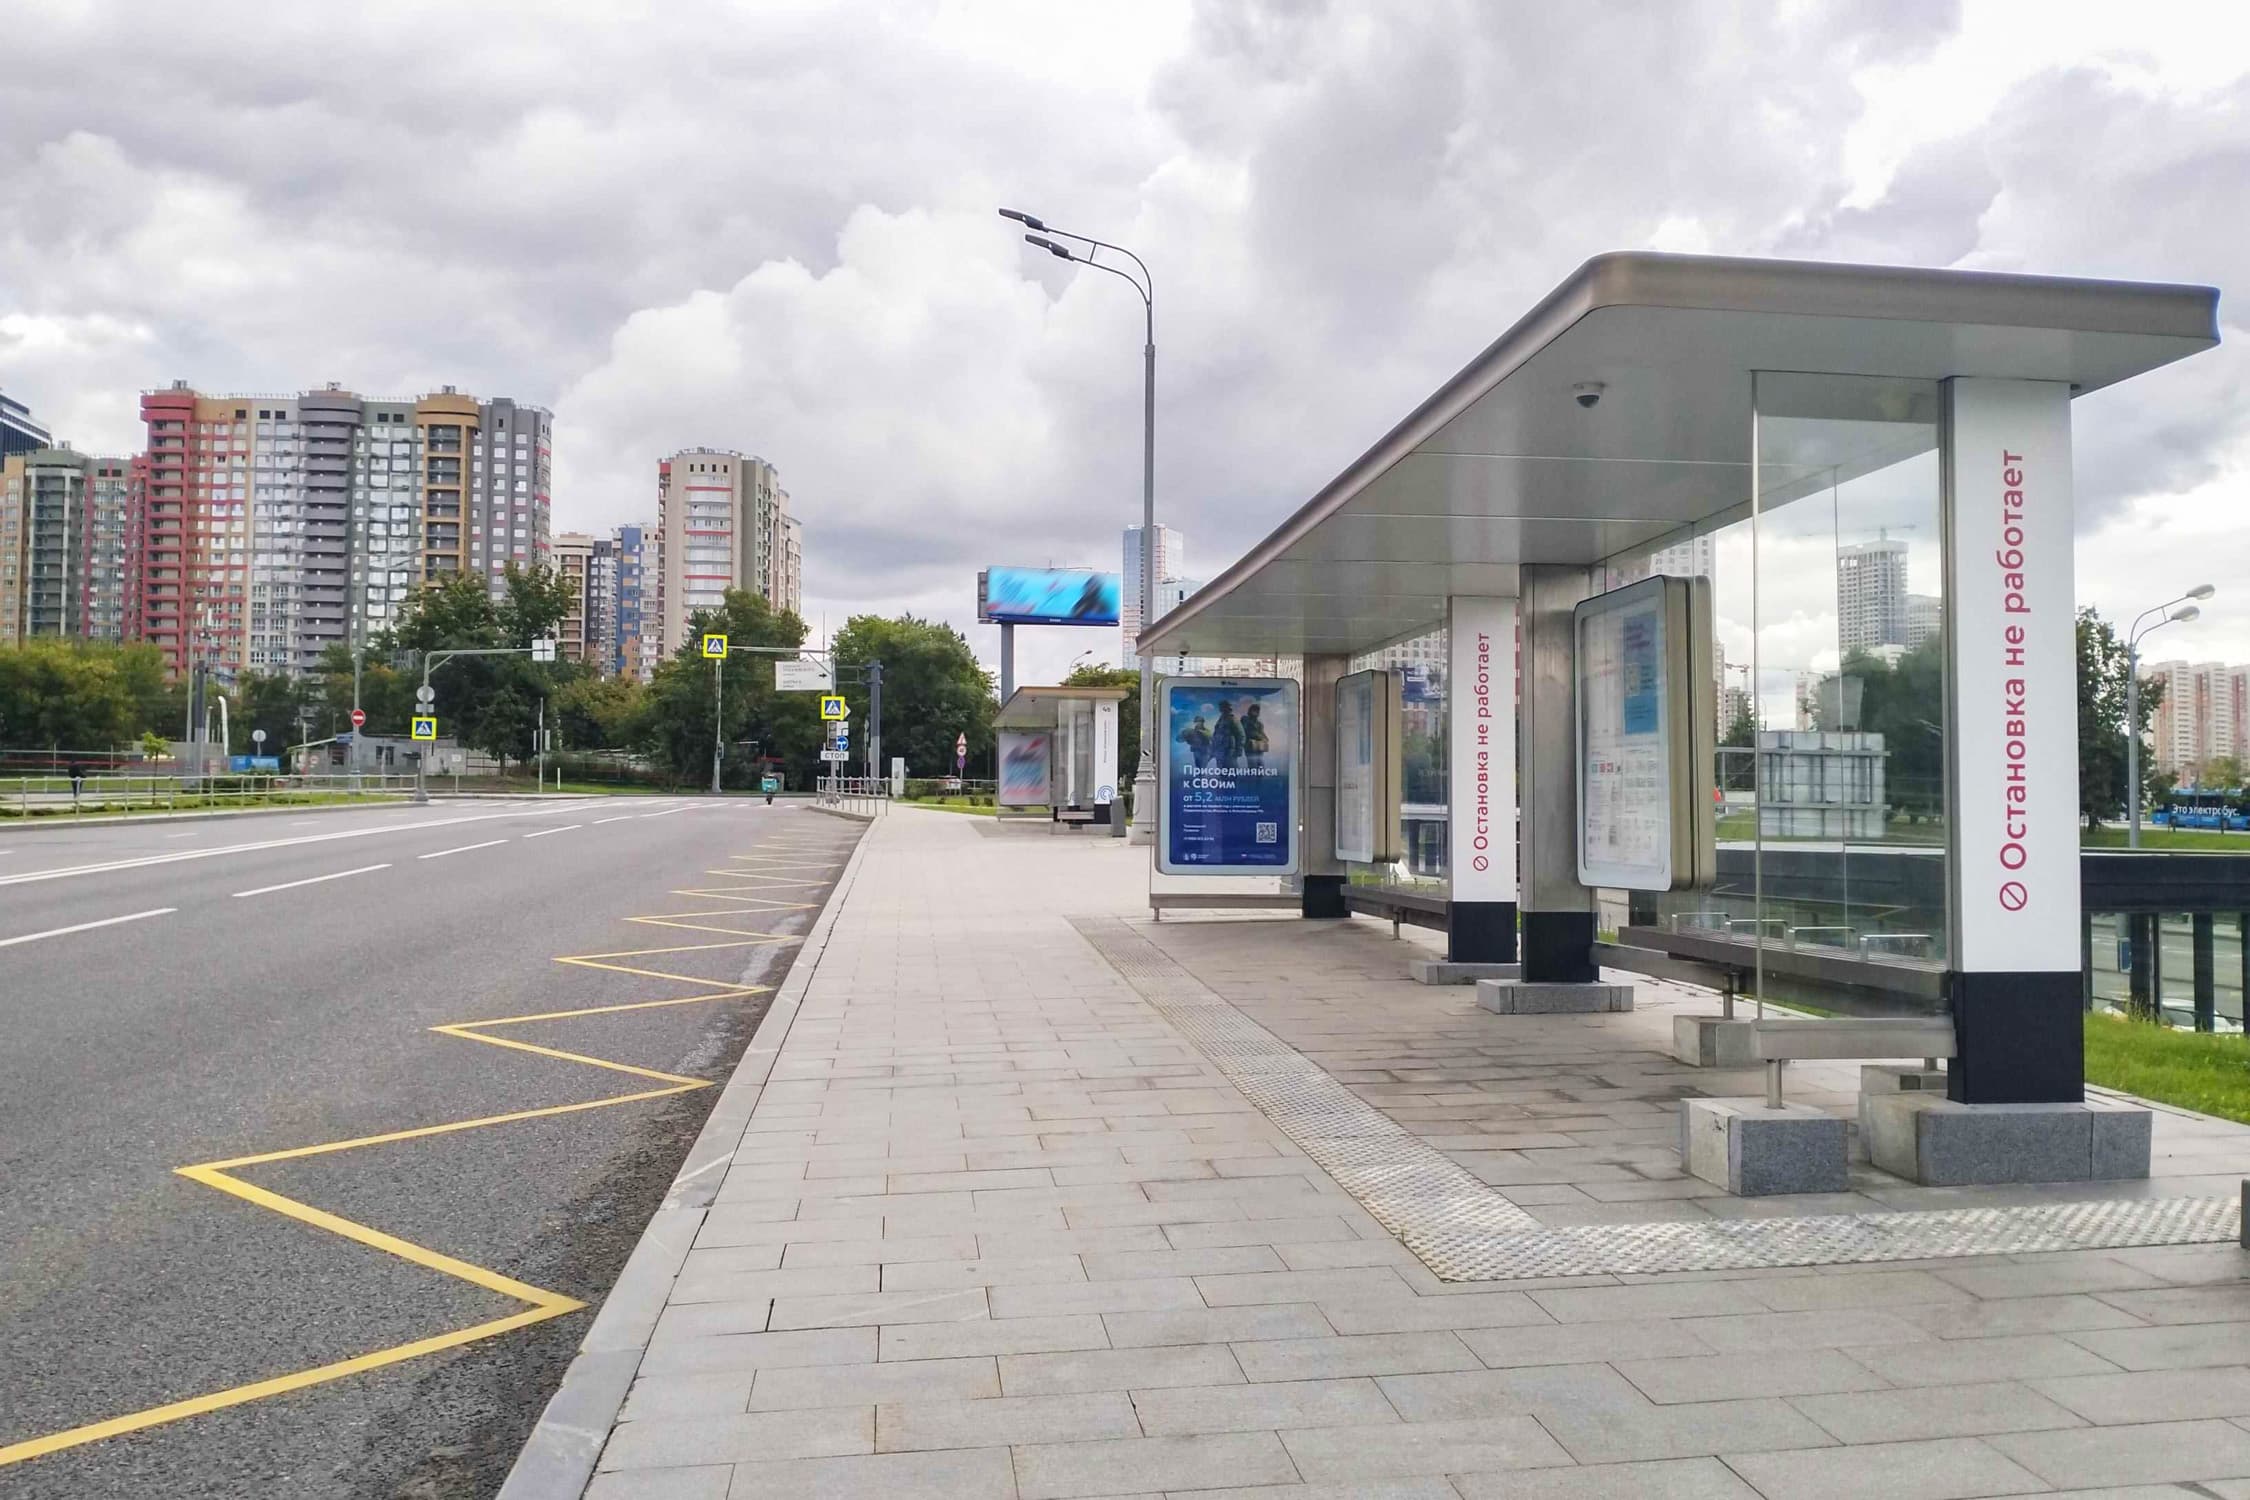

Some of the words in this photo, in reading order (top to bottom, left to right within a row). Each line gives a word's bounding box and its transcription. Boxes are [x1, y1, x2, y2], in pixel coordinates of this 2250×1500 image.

[1996, 450, 2031, 613] работает
[2005, 625, 2025, 666] не
[1474, 633, 1492, 718] работает
[1478, 724, 1489, 745] не
[1183, 764, 1278, 777] Присоединяйся
[1183, 780, 1190, 788] к
[1193, 778, 1235, 789] СВОим
[2000, 678, 2028, 870] Остановка
[1183, 794, 1193, 802] от
[1194, 791, 1213, 804] 5,2
[1473, 751, 1489, 851] Остановка
[2172, 803, 2188, 814] Это
